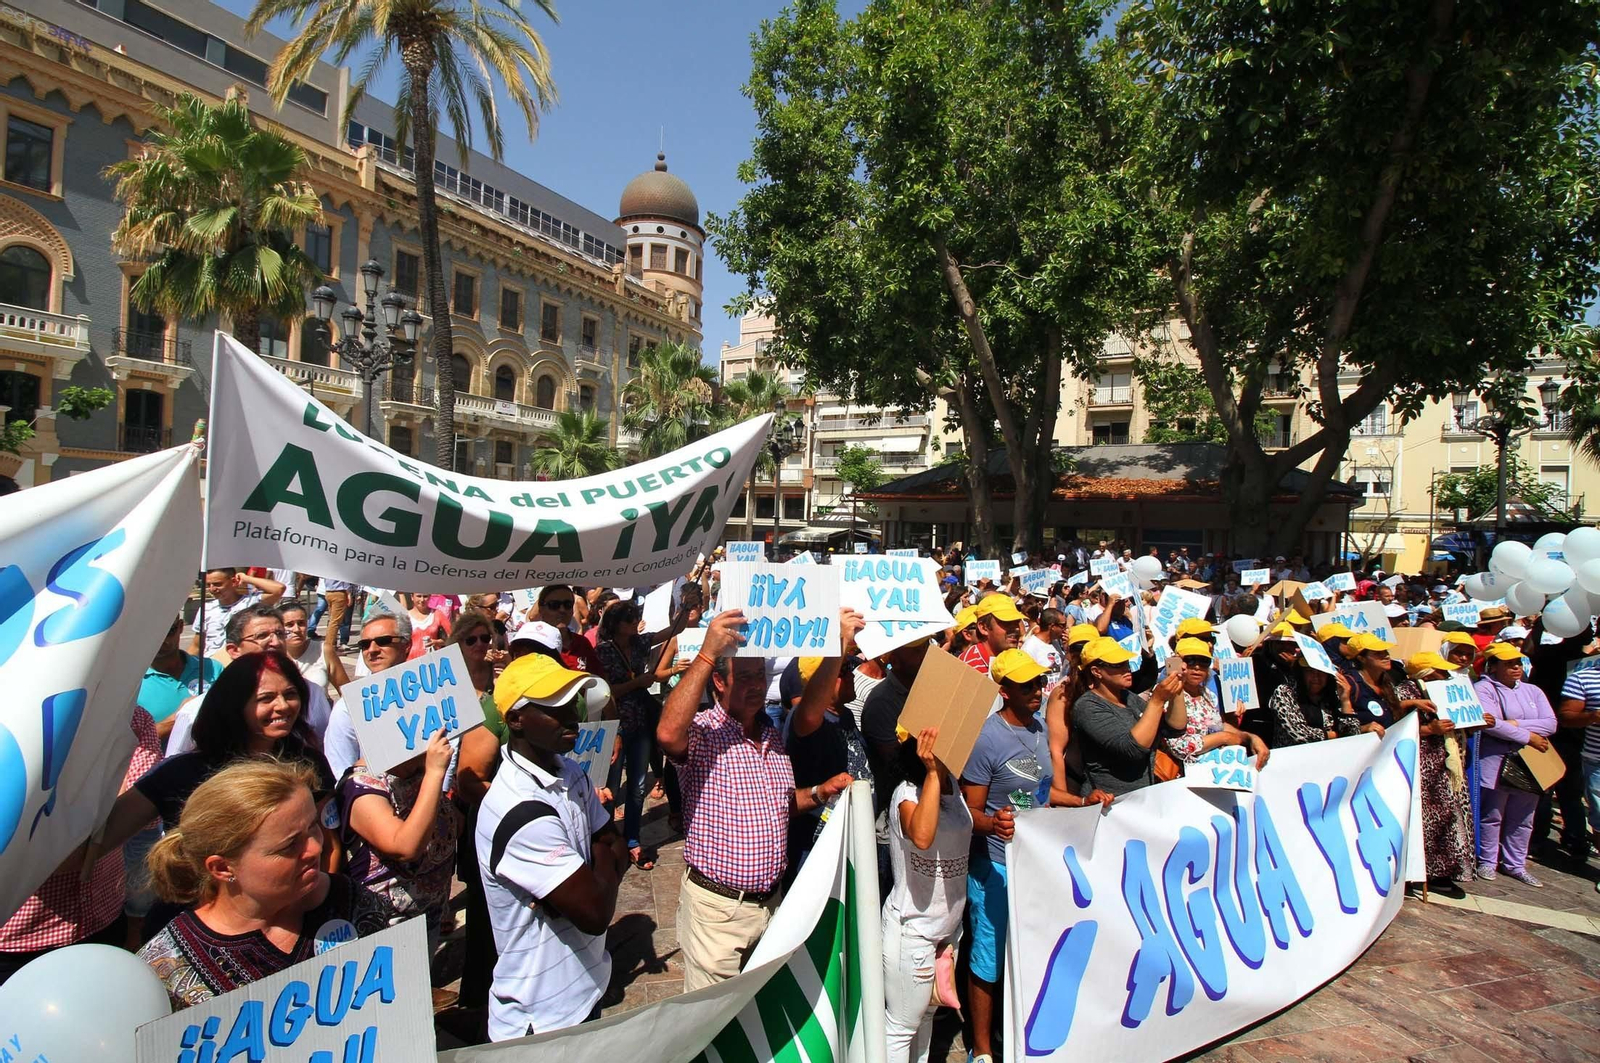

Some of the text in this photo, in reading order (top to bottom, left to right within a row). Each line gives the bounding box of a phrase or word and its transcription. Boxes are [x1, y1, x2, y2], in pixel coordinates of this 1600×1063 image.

[241, 442, 584, 563] AGUA
[510, 493, 571, 508] del
[580, 447, 731, 505] PUERTO
[233, 521, 338, 554] Plataforma
[344, 548, 385, 567] para
[392, 556, 407, 571] la
[414, 560, 487, 579] Defensa
[494, 568, 519, 580] del
[525, 569, 588, 582] Regadío
[593, 569, 613, 578] en
[617, 563, 632, 576] el
[633, 552, 684, 574] Condado
[686, 546, 698, 557] de
[844, 560, 925, 584] ¡¡AGUA
[748, 573, 806, 609] YA!!
[867, 586, 920, 612] YA!!
[361, 656, 457, 722] ¡¡AGUA
[396, 696, 459, 750] YA!!
